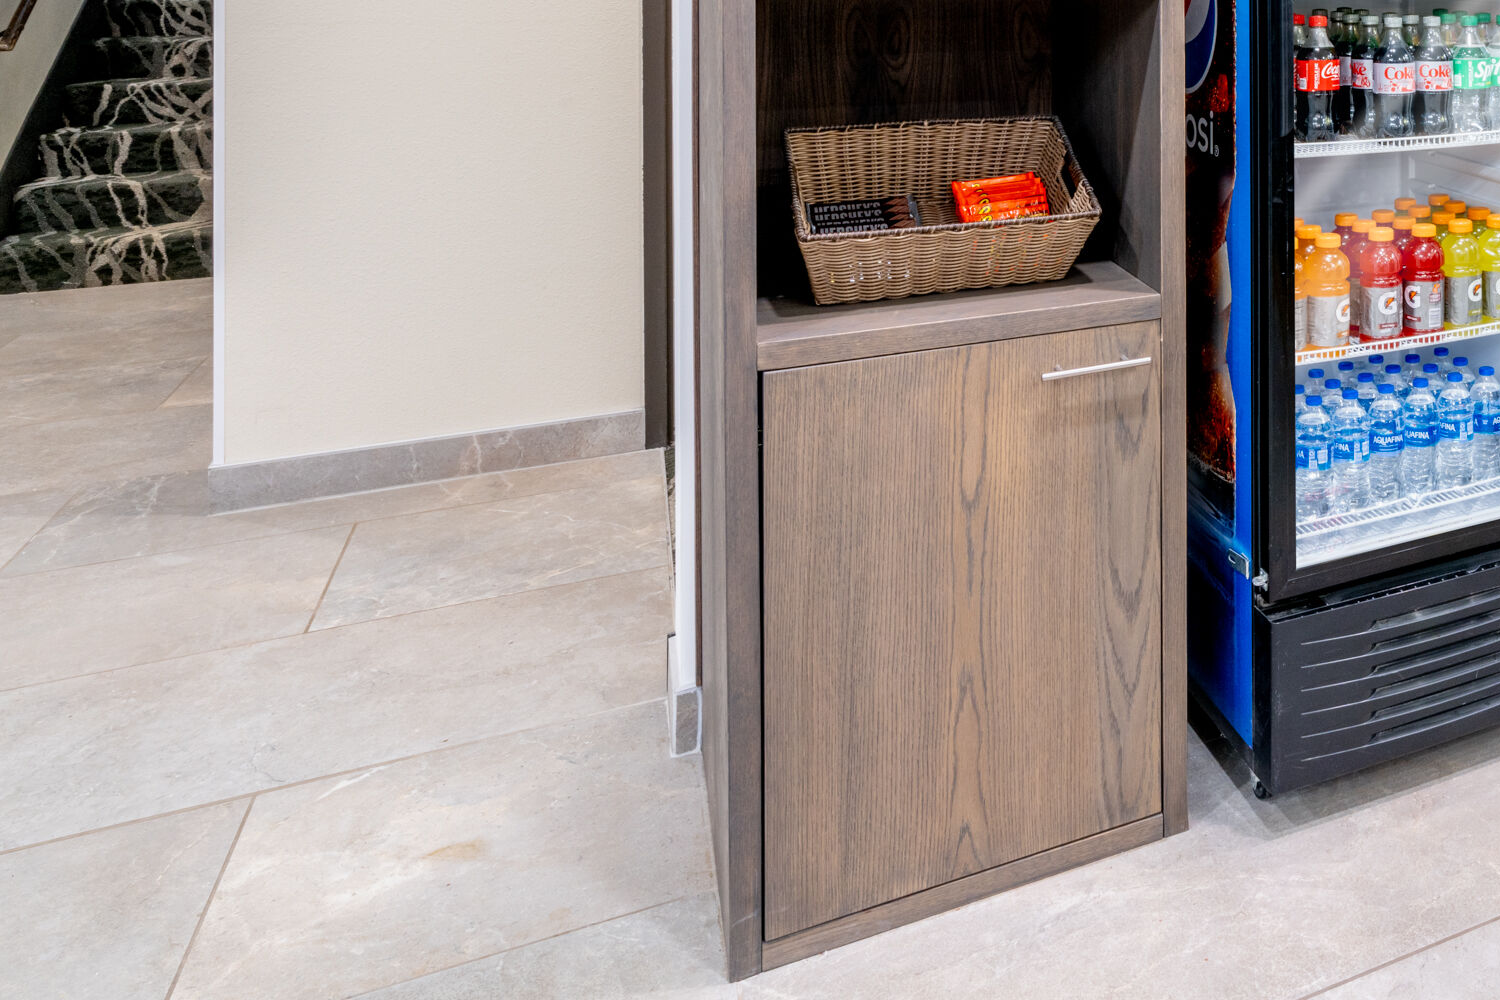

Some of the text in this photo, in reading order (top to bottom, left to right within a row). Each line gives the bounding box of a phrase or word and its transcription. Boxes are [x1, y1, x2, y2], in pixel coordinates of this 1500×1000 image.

[1419, 64, 1451, 78] Coke
[1186, 110, 1214, 154] psi
[1373, 434, 1403, 446] AQUAFINA
